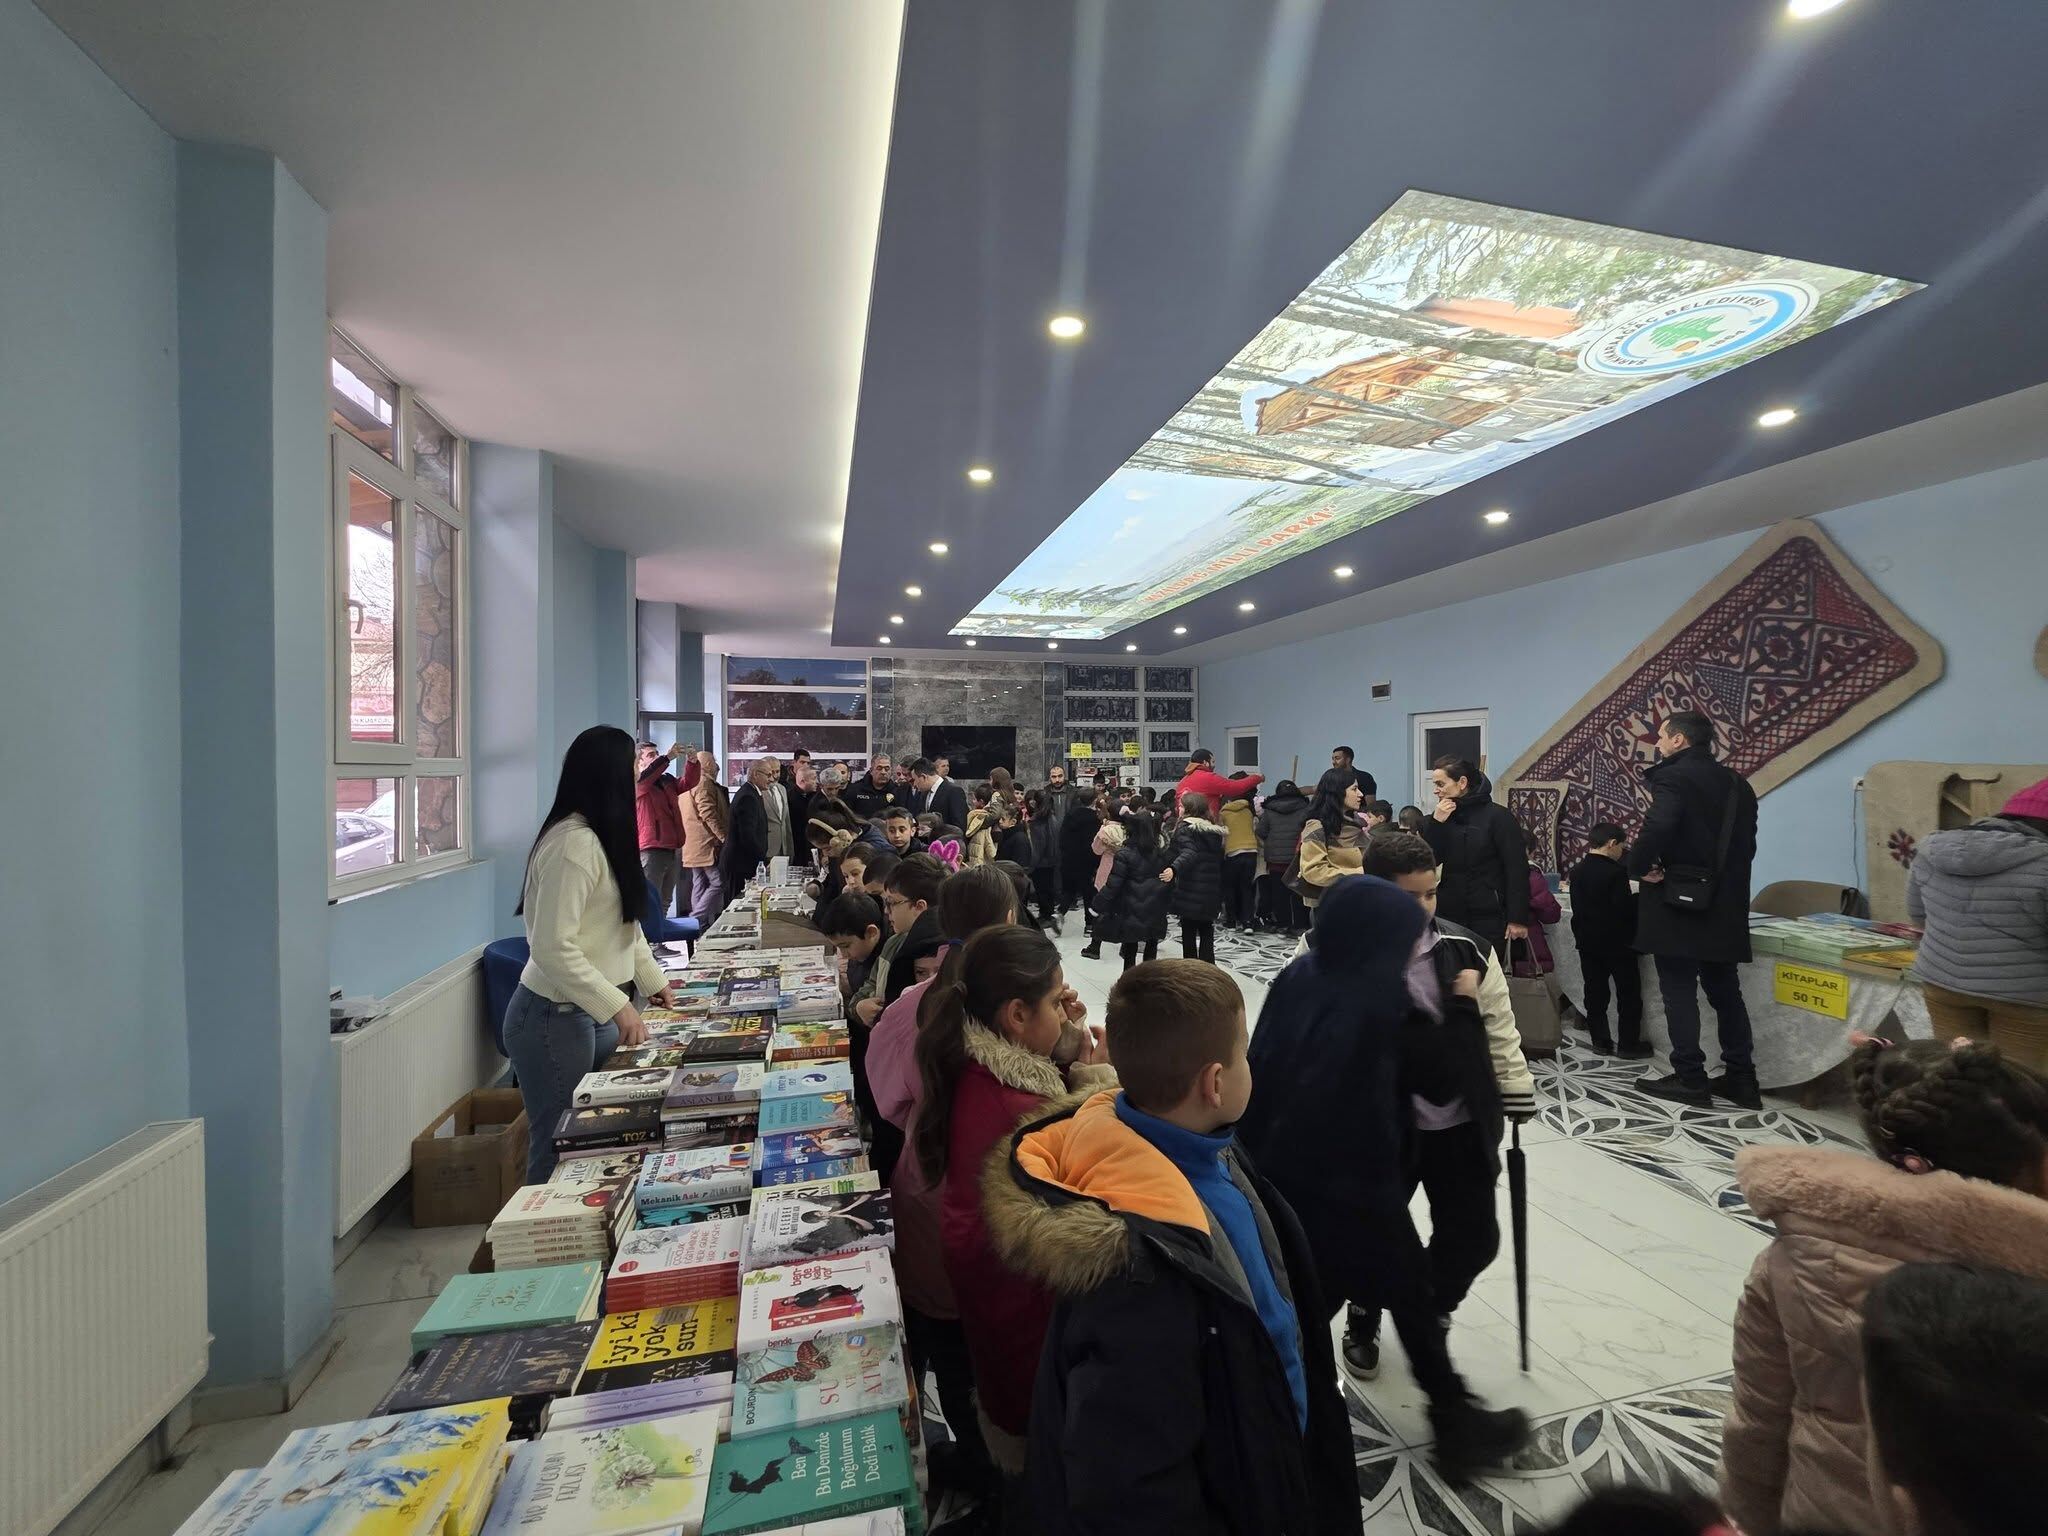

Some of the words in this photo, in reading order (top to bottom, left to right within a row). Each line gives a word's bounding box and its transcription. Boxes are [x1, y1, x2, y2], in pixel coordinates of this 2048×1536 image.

[1782, 971, 1838, 991] KİTAPLAR
[1793, 991, 1808, 1004] 50
[1812, 995, 1829, 1009] TL
[623, 1131, 647, 1142] TOZ
[643, 1154, 664, 1187] Mekanik
[640, 1194, 681, 1206] Mekanik
[610, 1312, 640, 1334] ki
[602, 1335, 640, 1364] iyi
[640, 1324, 672, 1358] yok
[768, 1337, 792, 1348] bende
[820, 1378, 840, 1406] SU
[746, 1387, 757, 1426] BOURDIN
[860, 1424, 876, 1454] Balık
[791, 1456, 807, 1480] Ben
[816, 1432, 830, 1481] Denizde
[840, 1428, 858, 1490] Boğulurum
[864, 1454, 880, 1484] Dedi
[816, 1482, 832, 1499] Bu
